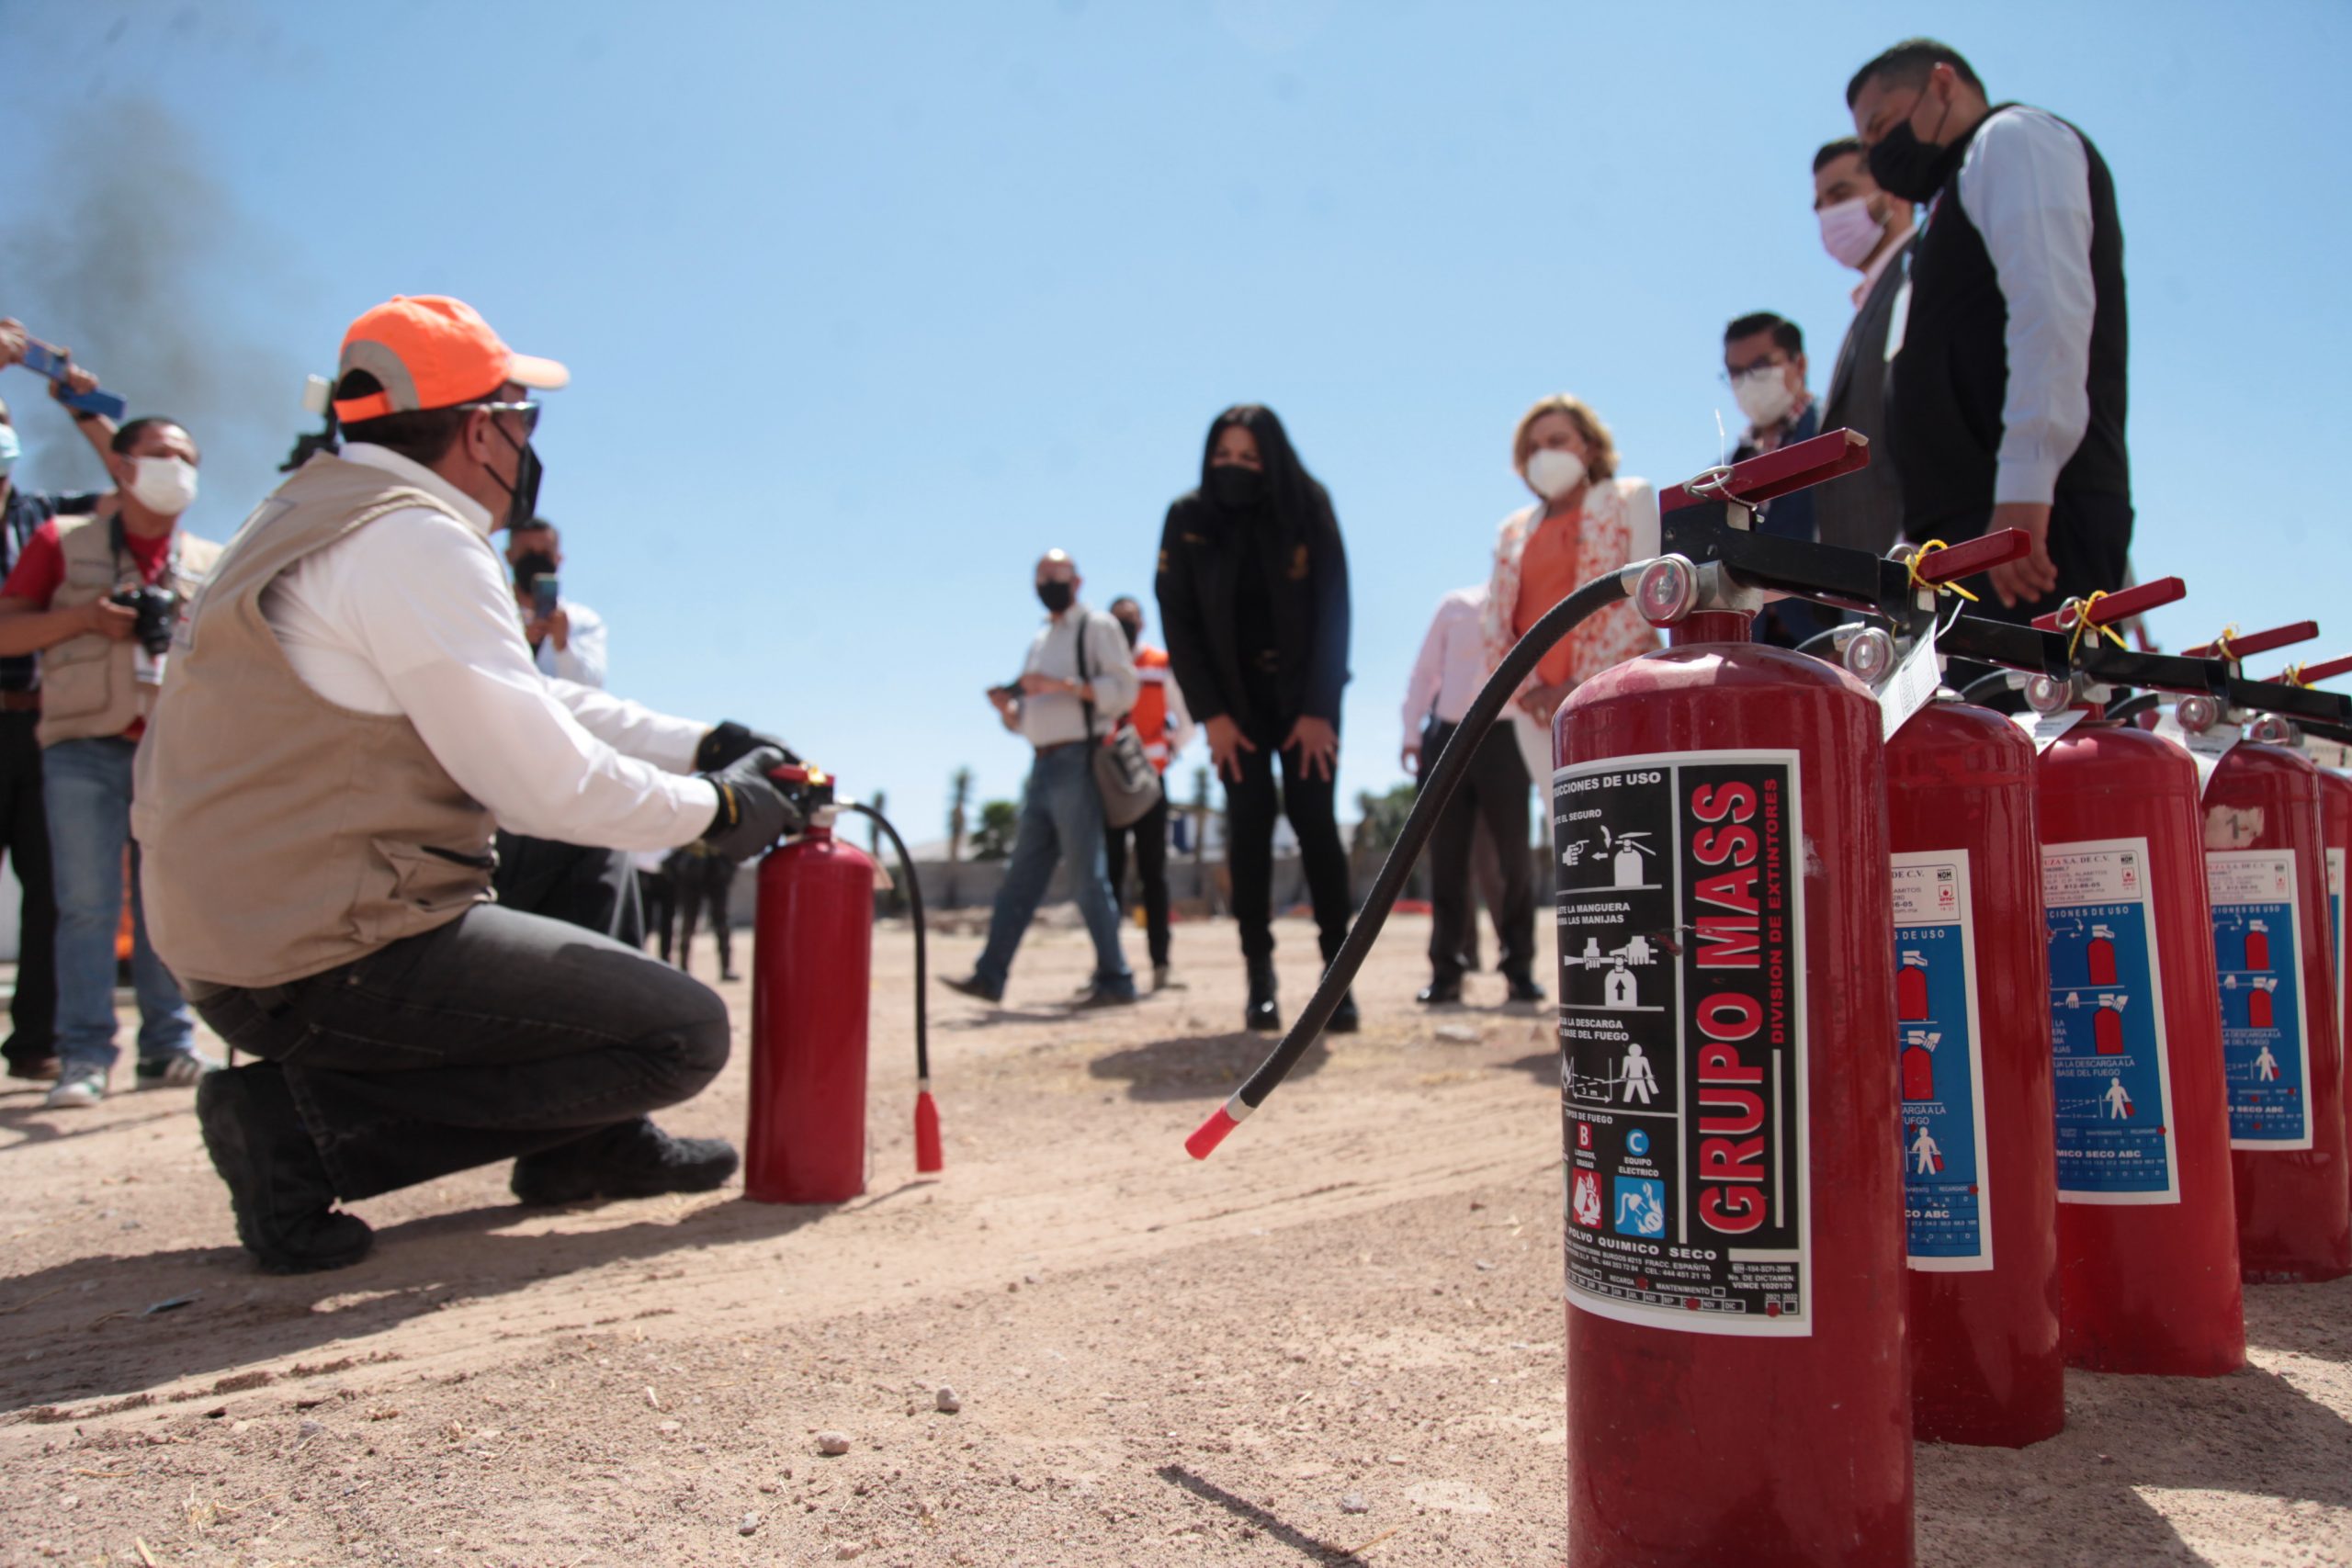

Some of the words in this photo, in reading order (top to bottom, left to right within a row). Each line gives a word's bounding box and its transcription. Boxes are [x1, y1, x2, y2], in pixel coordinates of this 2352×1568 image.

[1603, 775, 1622, 788] DE
[1626, 772, 1662, 785] USO
[1569, 808, 1602, 821] SEGURO
[2225, 813, 2240, 840] 1
[1763, 778, 1782, 909] EXTINTORES
[1691, 781, 1761, 969] MASS
[1906, 870, 1924, 879] C.V.
[1937, 871, 1951, 879] NOM
[1577, 902, 1631, 913] MANGUERA
[2091, 908, 2105, 916] DE
[2108, 906, 2130, 915] USO
[1568, 916, 1580, 925] LAS
[1582, 914, 1624, 925] MANIJAS
[1768, 916, 1783, 943] DE
[1902, 930, 1917, 940] DE
[1920, 929, 1945, 939] USO
[1770, 948, 1785, 1044] DIVISION
[1576, 1019, 1623, 1029] DESCARGA
[1577, 1031, 1592, 1039] DEL
[1594, 1032, 1629, 1041] FUEGO
[2052, 1028, 2067, 1036] ERA
[2075, 1059, 2117, 1068] DESCARGA
[2124, 1058, 2135, 1066] LA
[2056, 1068, 2075, 1077] BASE
[2076, 1068, 2091, 1077] DEL
[2092, 1067, 2120, 1077] FUEGO
[1582, 1087, 1587, 1095] 3
[1696, 991, 1767, 1235] GRUPO
[1902, 1106, 1928, 1114] ARGA
[1935, 1106, 1947, 1114] LA
[2265, 1105, 2284, 1113] ABC
[1578, 1111, 1587, 1121] DE
[1588, 1113, 1613, 1124] FUEGO
[1902, 1116, 1929, 1125] UEGO
[1579, 1124, 1589, 1146] B
[1630, 1132, 1643, 1152] C
[2056, 1150, 2083, 1158] MICO
[2086, 1150, 2115, 1158] SECO
[1624, 1156, 1653, 1167] EQUIPO
[1618, 1166, 1659, 1177] ELECTRICO
[1905, 1210, 1921, 1219] CO
[1924, 1210, 1950, 1218] ABC
[1568, 1226, 1593, 1244] POLVO
[1598, 1236, 1659, 1256] QUIMICO
[1668, 1247, 1717, 1260] SECO
[1602, 1251, 1626, 1262] BURGOS
[1609, 1274, 1635, 1286] RECARGA
[1663, 1269, 1676, 1278] 444
[1677, 1270, 1690, 1279] 451
[1702, 1272, 1712, 1280] 10
[1742, 1274, 1754, 1282] DE
[1755, 1274, 1794, 1282] DICTAMEN
[1656, 1282, 1711, 1295] MANTENIMIENTO
[1732, 1281, 1759, 1290] VENCE
[1703, 1300, 1715, 1309] NOV
[1724, 1302, 1736, 1311] DIC
